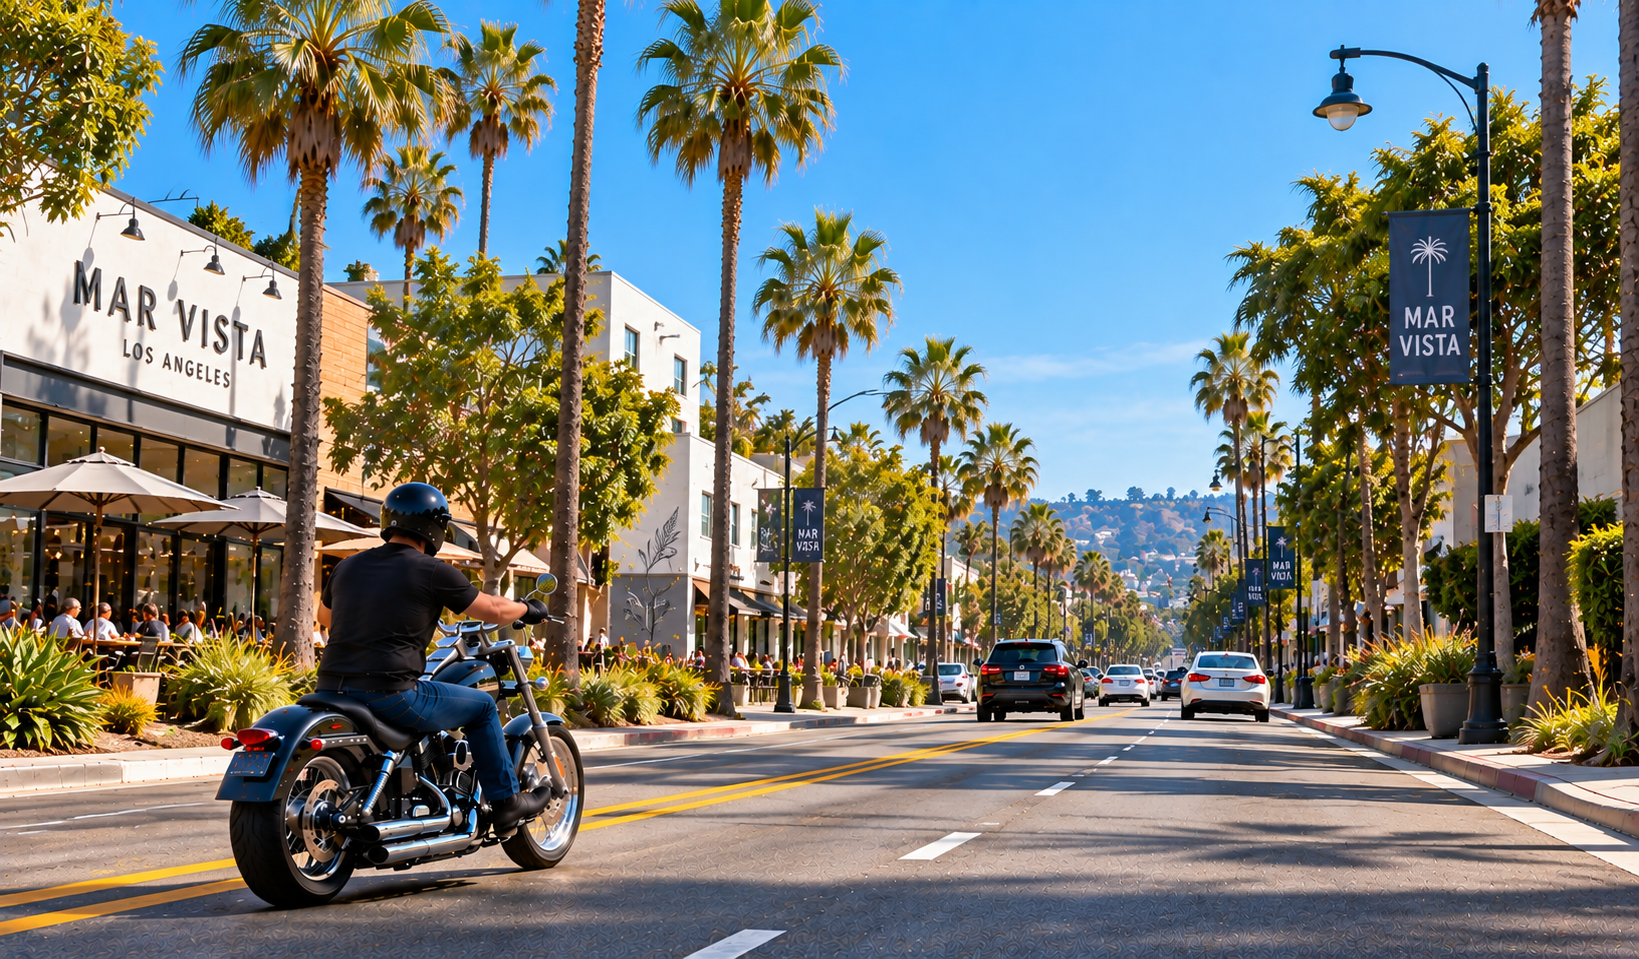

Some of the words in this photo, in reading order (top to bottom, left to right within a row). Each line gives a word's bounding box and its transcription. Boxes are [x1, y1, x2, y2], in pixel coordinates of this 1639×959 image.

[73, 259, 157, 331] MAR
[177, 299, 267, 370] VISTA
[1404, 305, 1455, 329] MAR
[1399, 333, 1461, 356] VISTA
[123, 339, 154, 364] LOS
[162, 353, 231, 388] ANGELES
